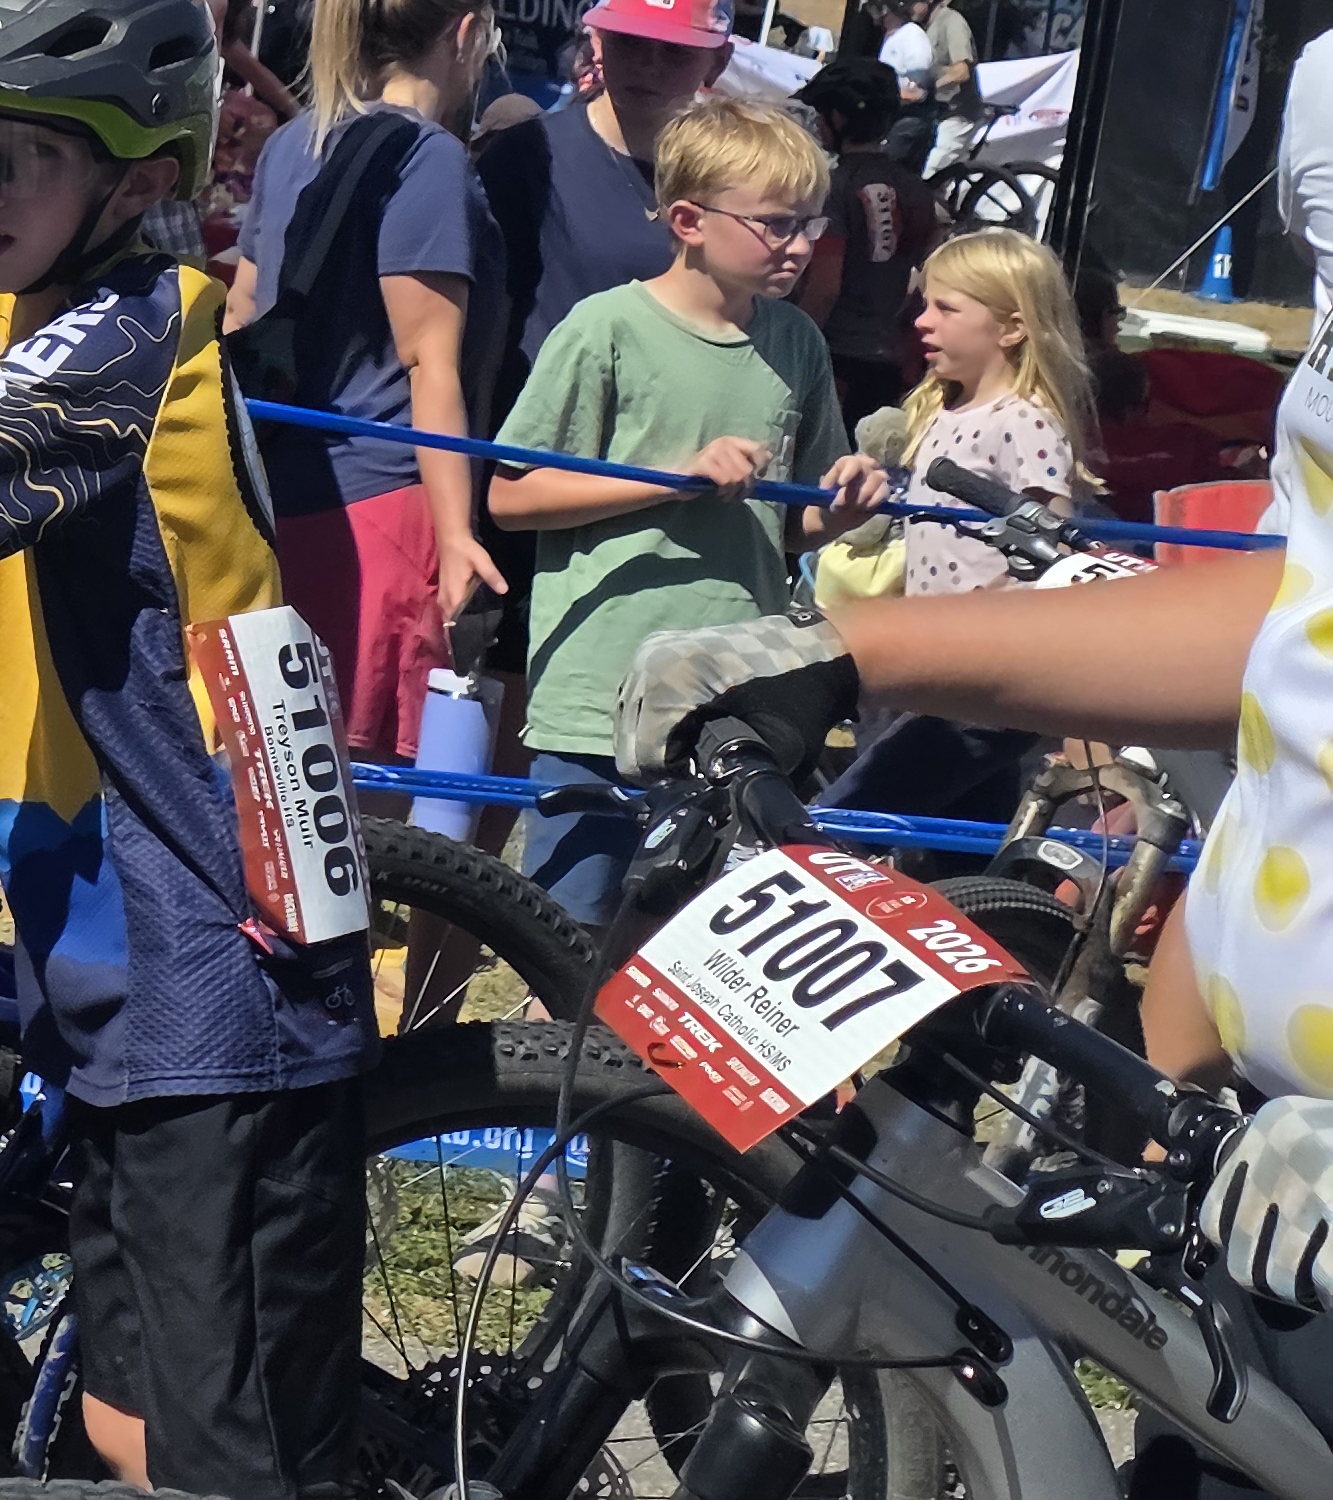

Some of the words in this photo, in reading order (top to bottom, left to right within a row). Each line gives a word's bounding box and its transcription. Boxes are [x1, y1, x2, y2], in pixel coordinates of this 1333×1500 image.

[218, 628, 240, 677] SRAM
[264, 726, 289, 803] Bonneville
[272, 699, 301, 793] Treyson
[294, 798, 315, 849] Muir
[278, 642, 358, 897] 51006
[709, 870, 925, 1032] 51007
[906, 919, 1002, 974] 2026
[668, 960, 694, 985] Saint
[685, 977, 721, 1009] Joseph
[717, 1004, 758, 1046] Catholic
[755, 1038, 792, 1072] HS/MS
[678, 1011, 723, 1053] TREK
[703, 948, 752, 994] Wilder
[743, 985, 800, 1038] Reiner
